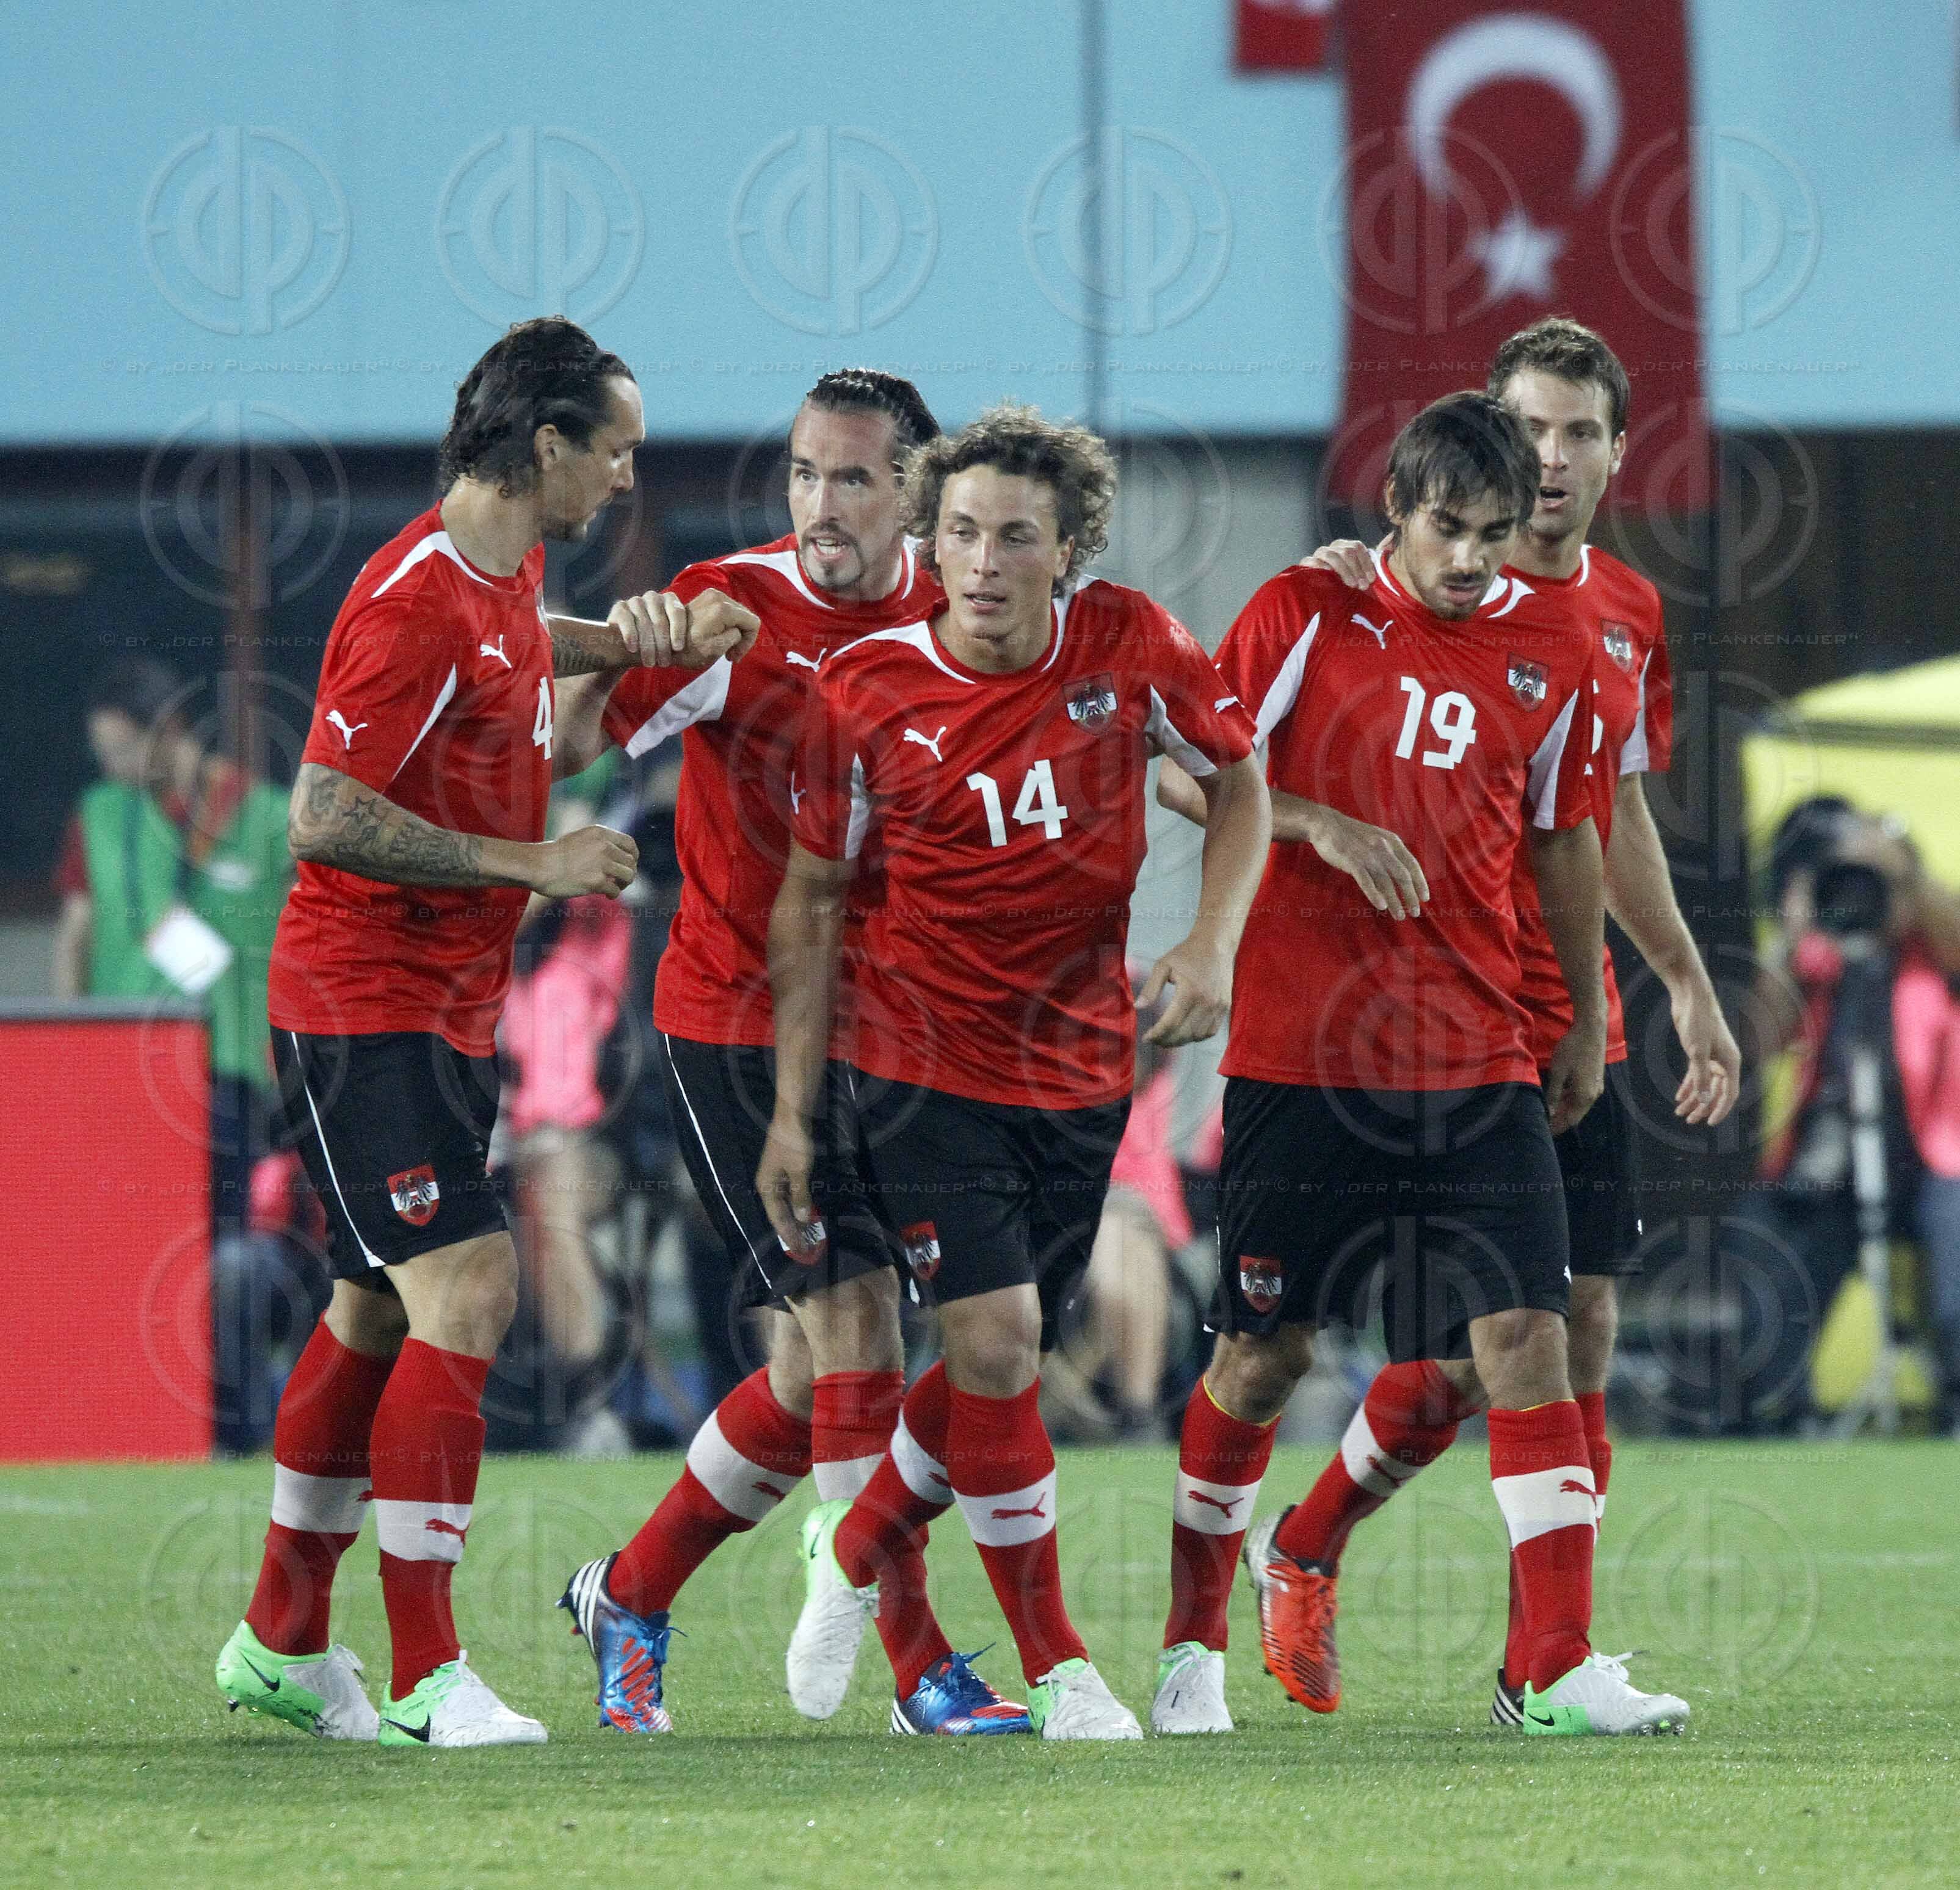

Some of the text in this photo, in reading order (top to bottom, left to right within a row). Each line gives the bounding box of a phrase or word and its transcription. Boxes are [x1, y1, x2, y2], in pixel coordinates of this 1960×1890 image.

[532, 676, 553, 761] 4
[1395, 676, 1476, 769] 19
[966, 759, 1069, 847] 14
